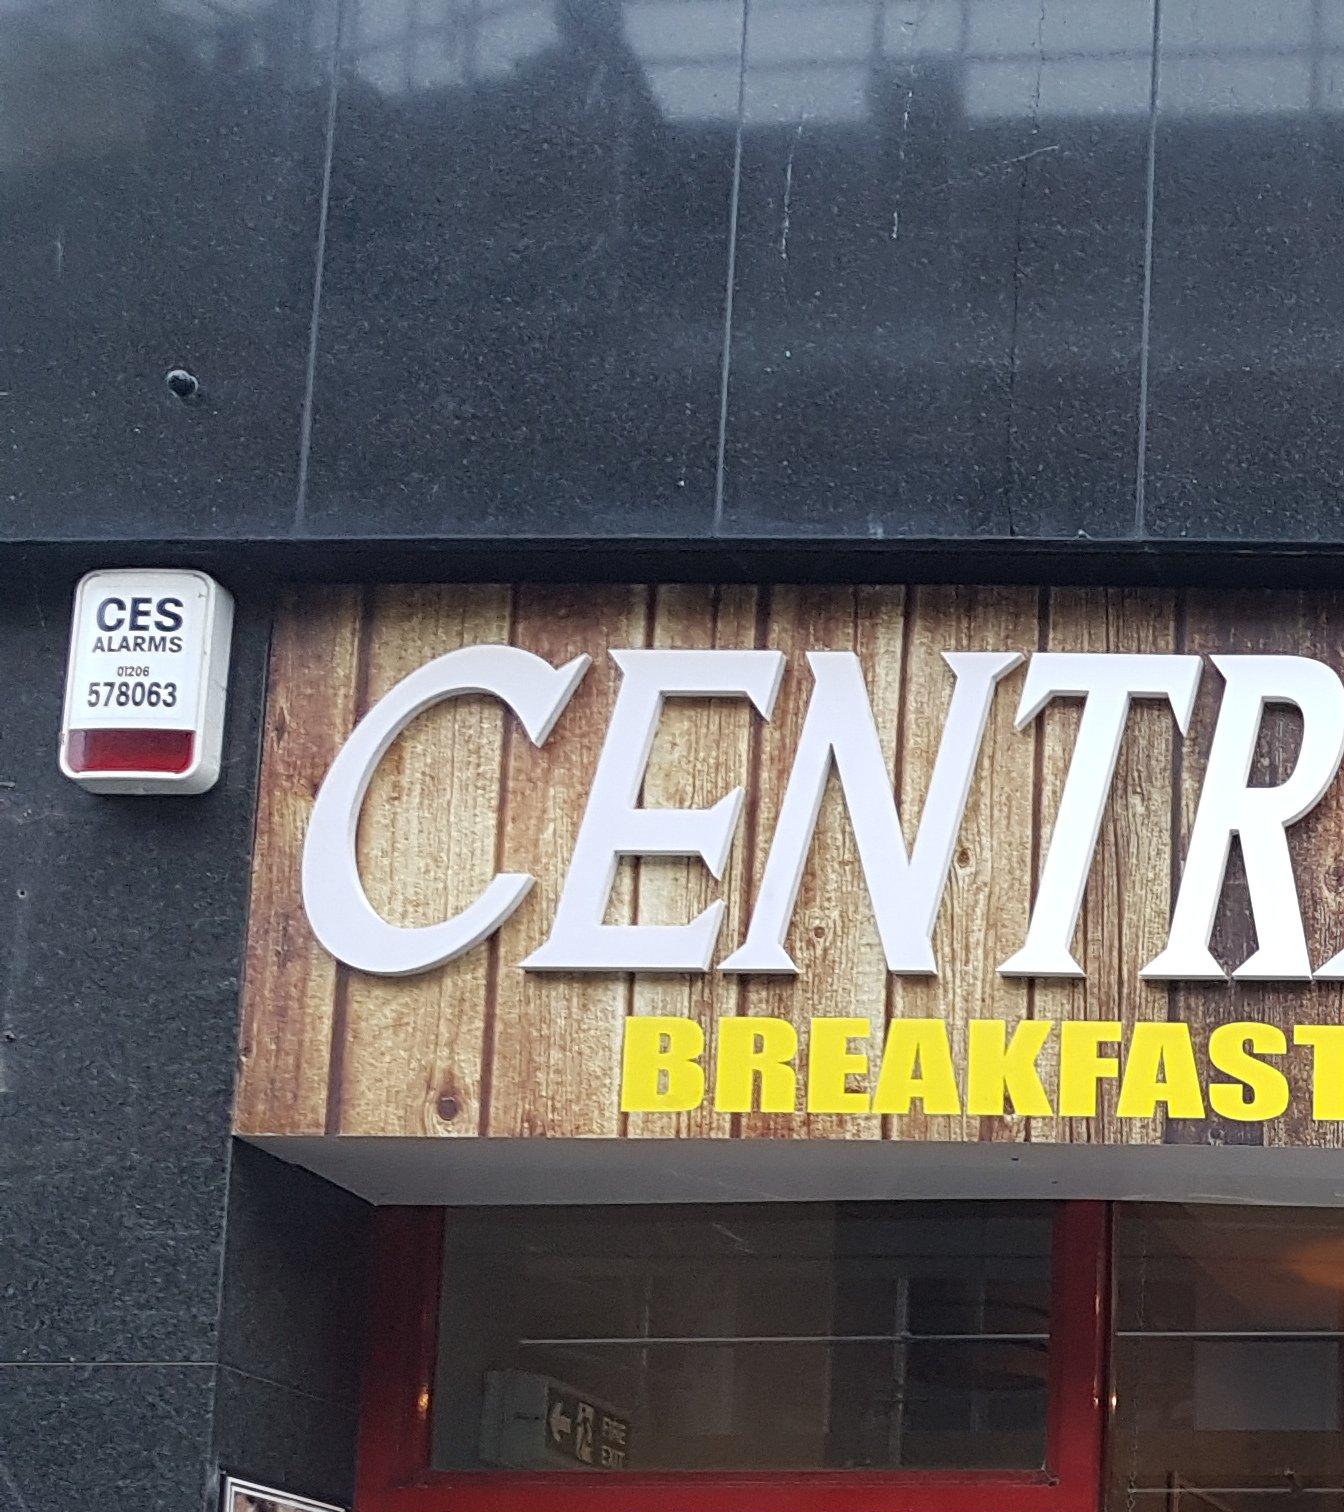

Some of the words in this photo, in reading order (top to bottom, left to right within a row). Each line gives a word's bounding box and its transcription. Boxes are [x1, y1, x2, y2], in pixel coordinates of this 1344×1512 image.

[96, 596, 184, 632] CES
[92, 635, 183, 653] ALARMS
[117, 666, 150, 678] 01206
[87, 681, 177, 708] 578063
